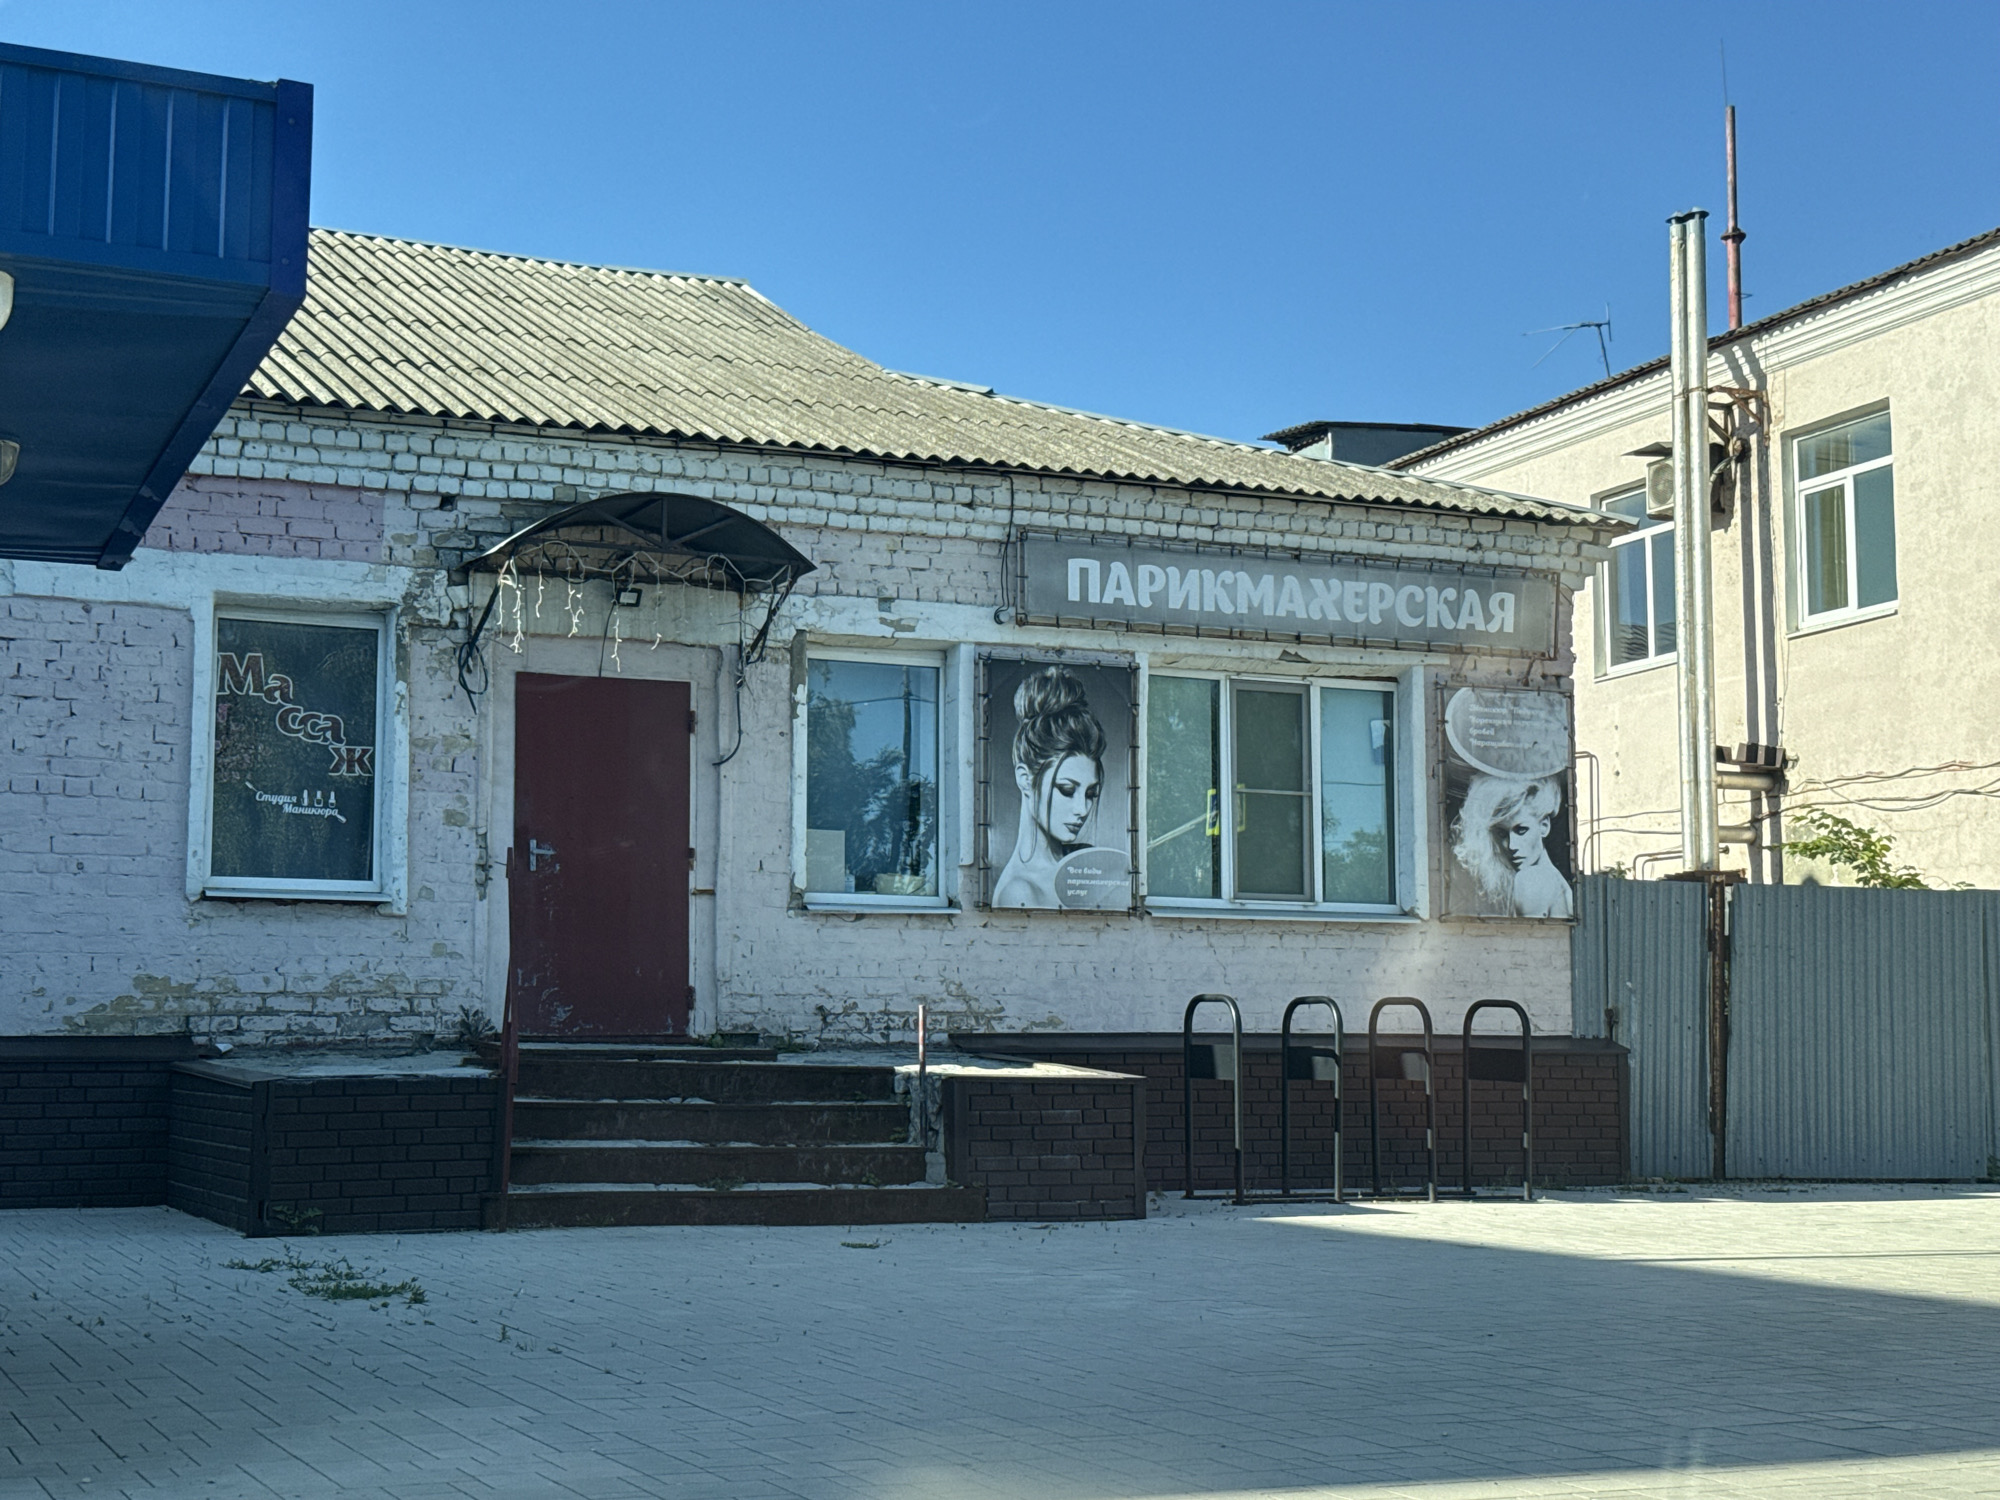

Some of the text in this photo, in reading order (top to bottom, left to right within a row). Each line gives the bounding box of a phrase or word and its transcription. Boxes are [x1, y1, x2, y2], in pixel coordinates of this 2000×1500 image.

[1066, 557, 1516, 634] ПАРИКМАХЕРСКАЯ
[255, 790, 298, 805] Студия
[282, 803, 339, 819] Маникюра
[1066, 866, 1102, 875] Все виды
[1066, 889, 1088, 897] услуг
